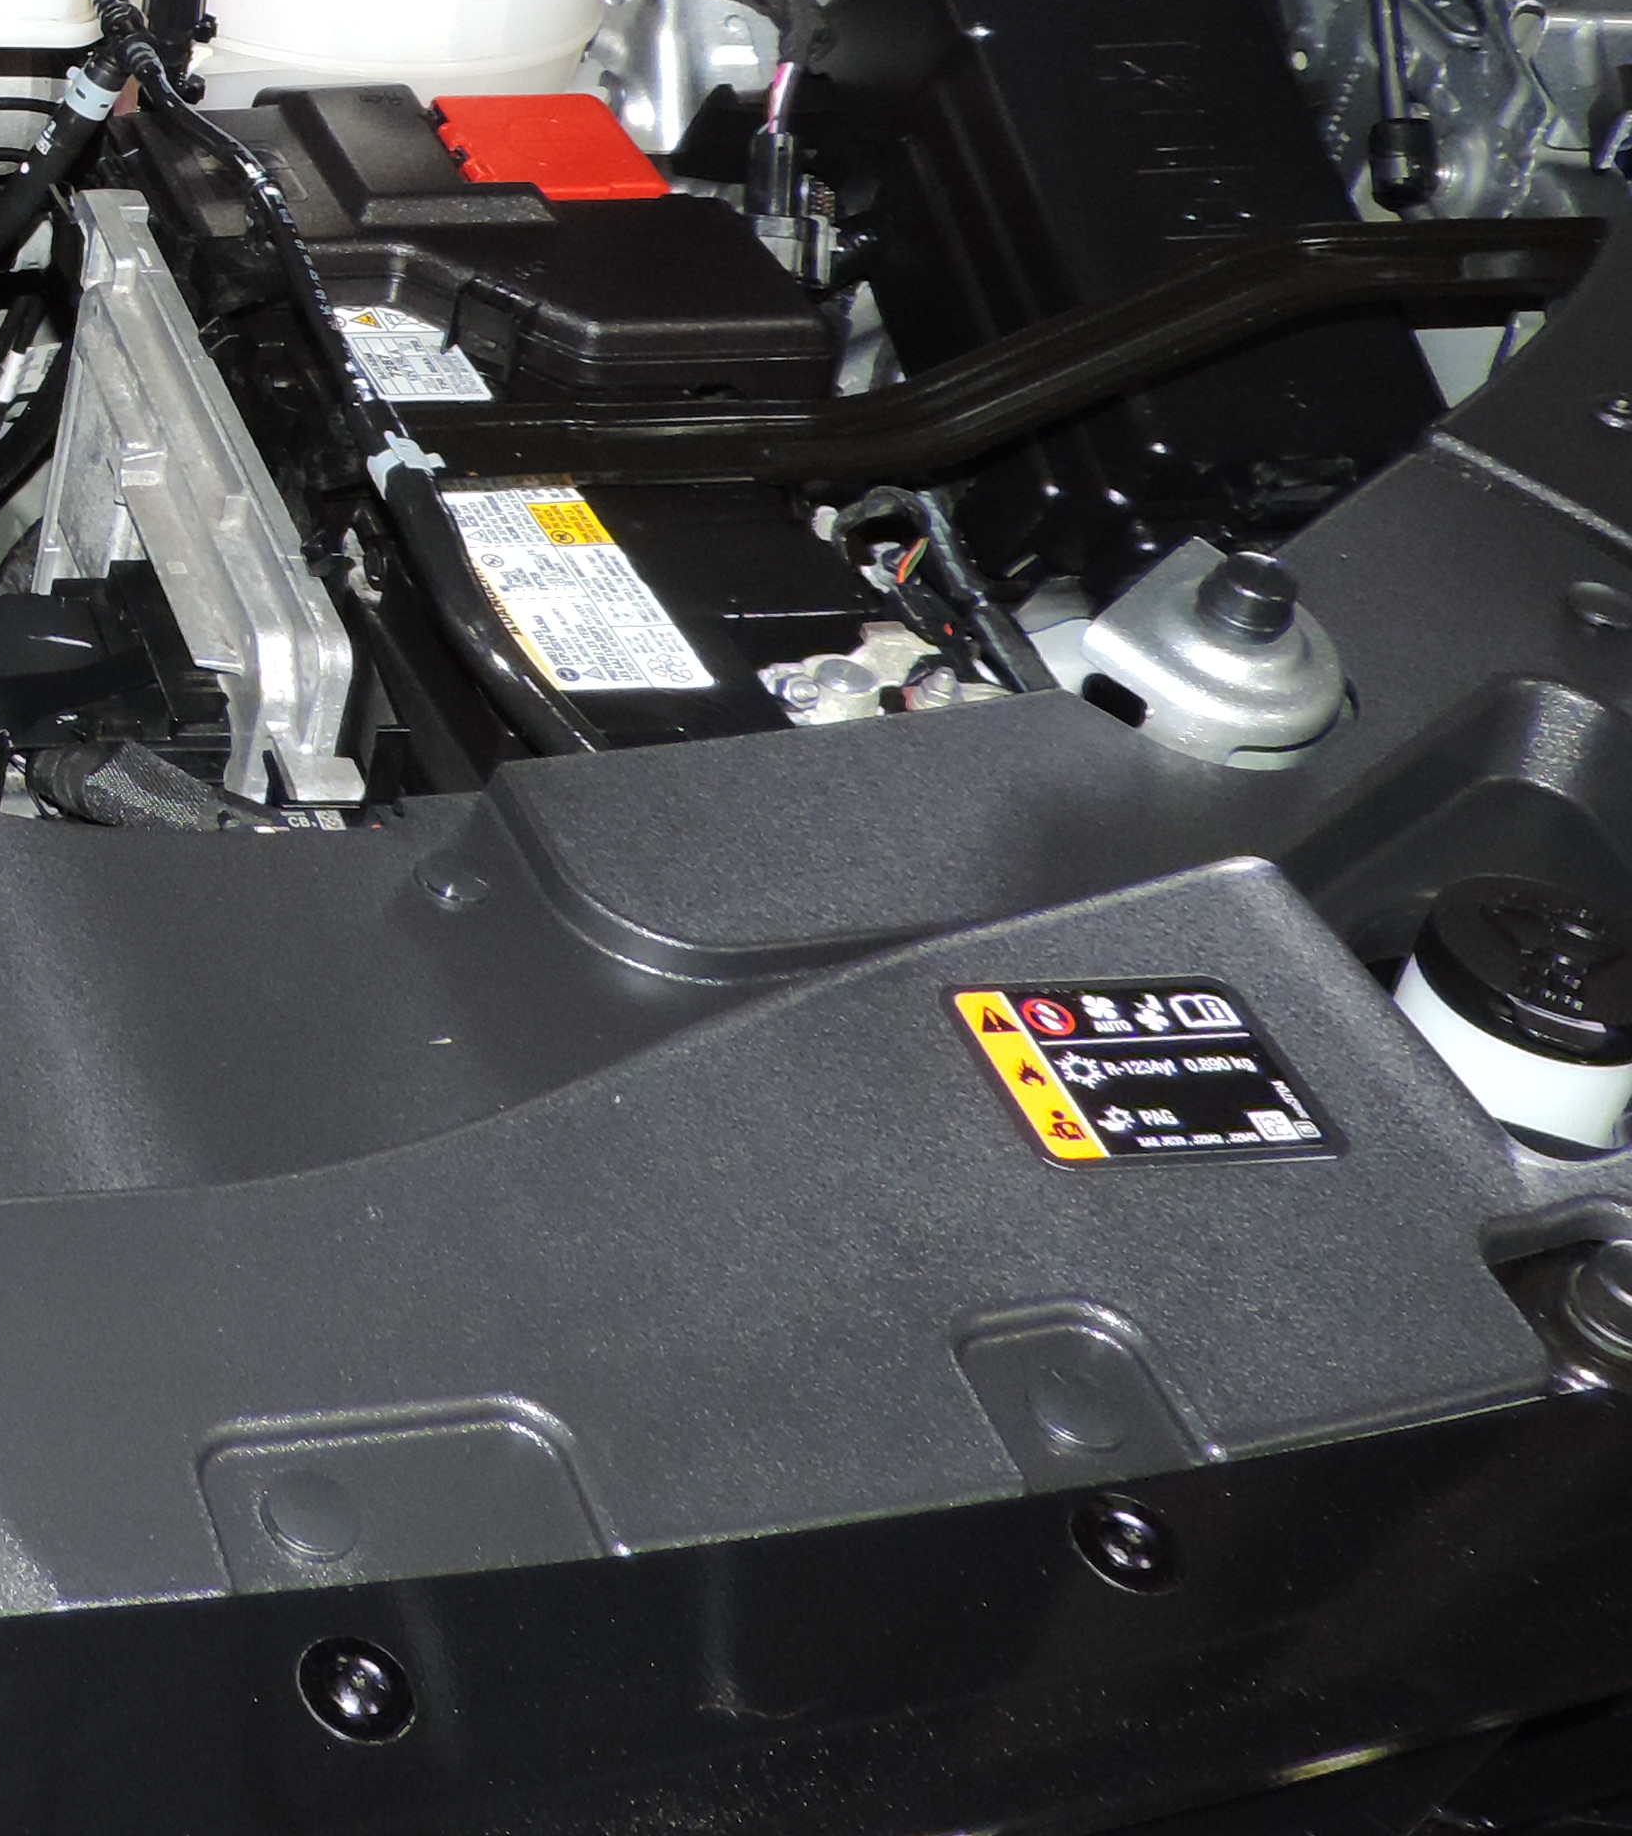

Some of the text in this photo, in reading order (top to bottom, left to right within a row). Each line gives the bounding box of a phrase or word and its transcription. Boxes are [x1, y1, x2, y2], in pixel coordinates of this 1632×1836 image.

[1093, 1019, 1134, 1033] AUTO
[1102, 1056, 1259, 1077] R-1234yf 0.890 kg
[1138, 1109, 1180, 1126] PAG
